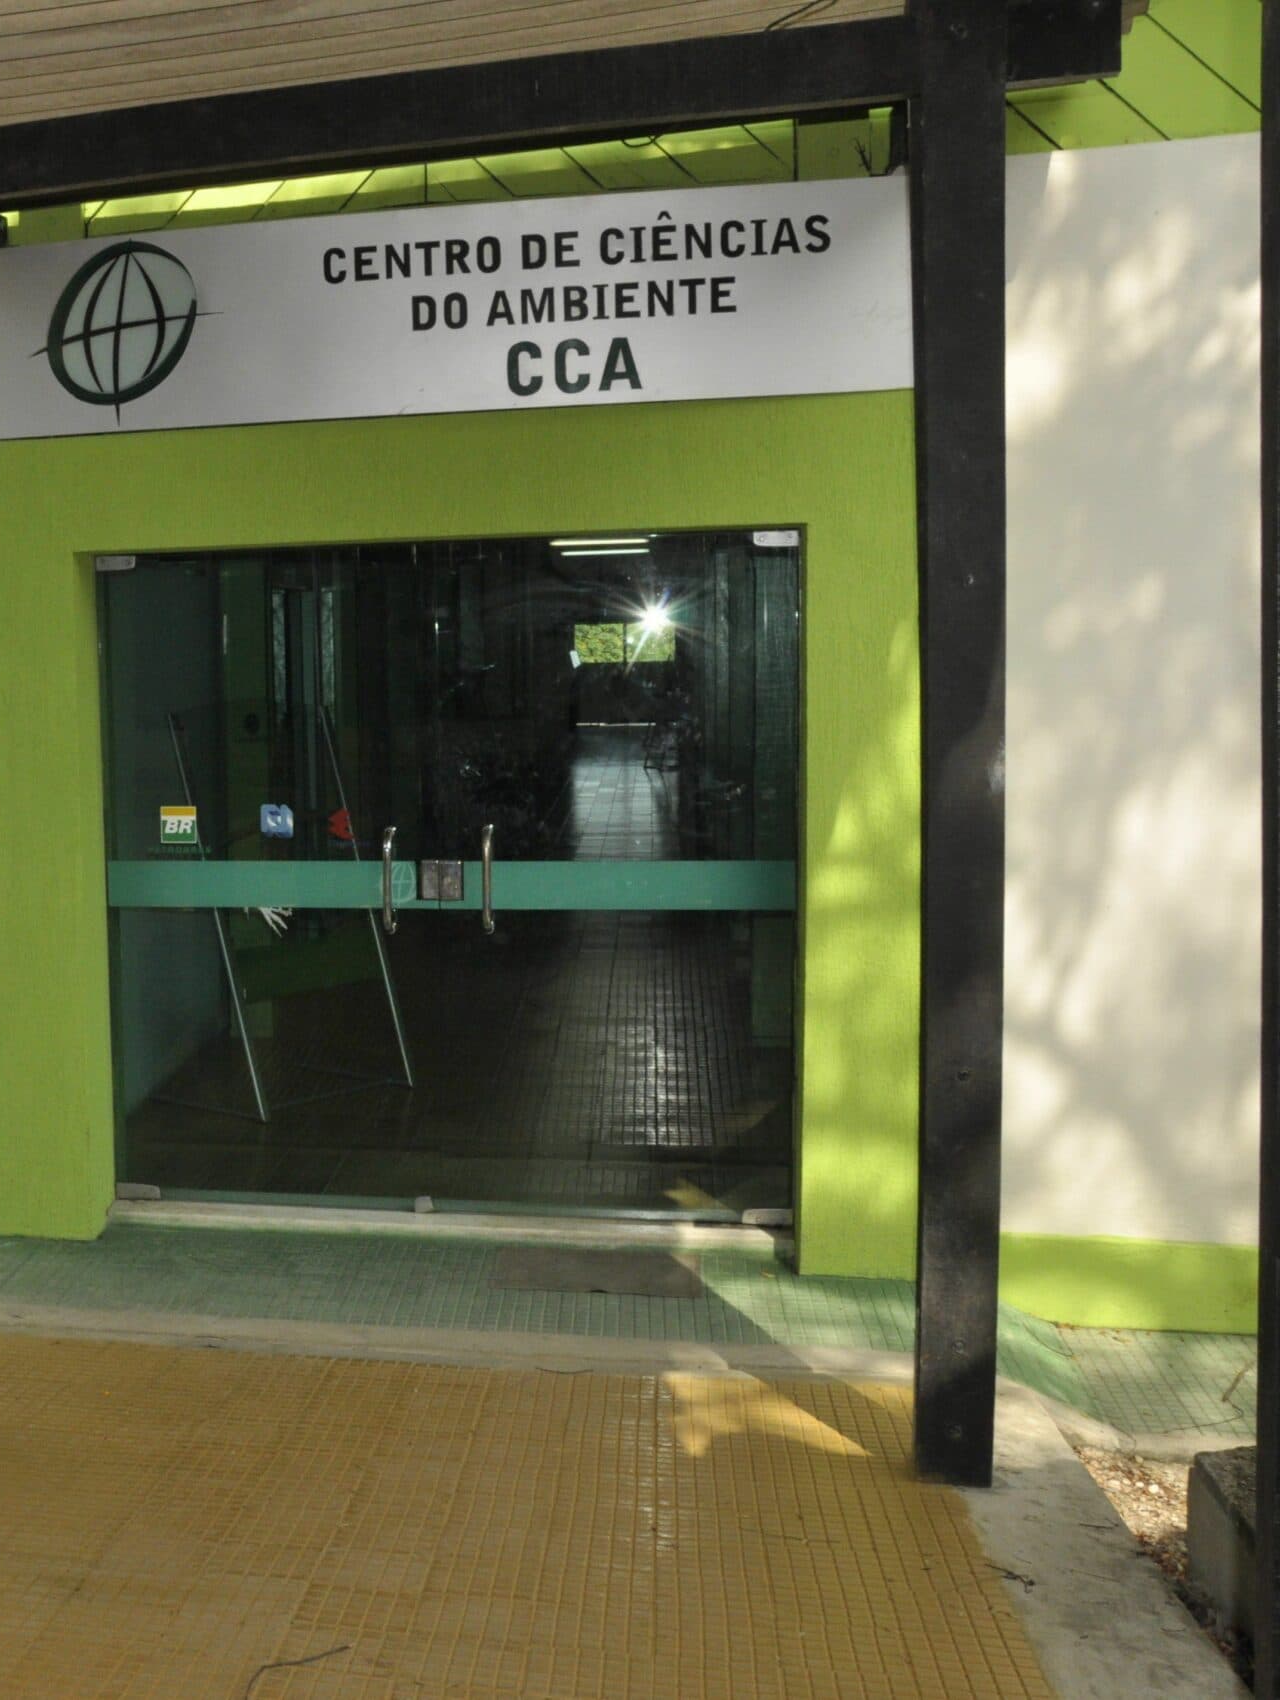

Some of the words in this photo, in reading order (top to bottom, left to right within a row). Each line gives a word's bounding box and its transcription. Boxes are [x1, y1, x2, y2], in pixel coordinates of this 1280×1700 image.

[323, 233, 501, 285] CENTRO
[521, 231, 580, 270] DE
[599, 210, 831, 266] CIÊNCIAS
[411, 291, 468, 331] DO
[486, 275, 738, 328] AMBIENTE
[506, 336, 643, 397] CCA
[164, 816, 193, 834] BR
